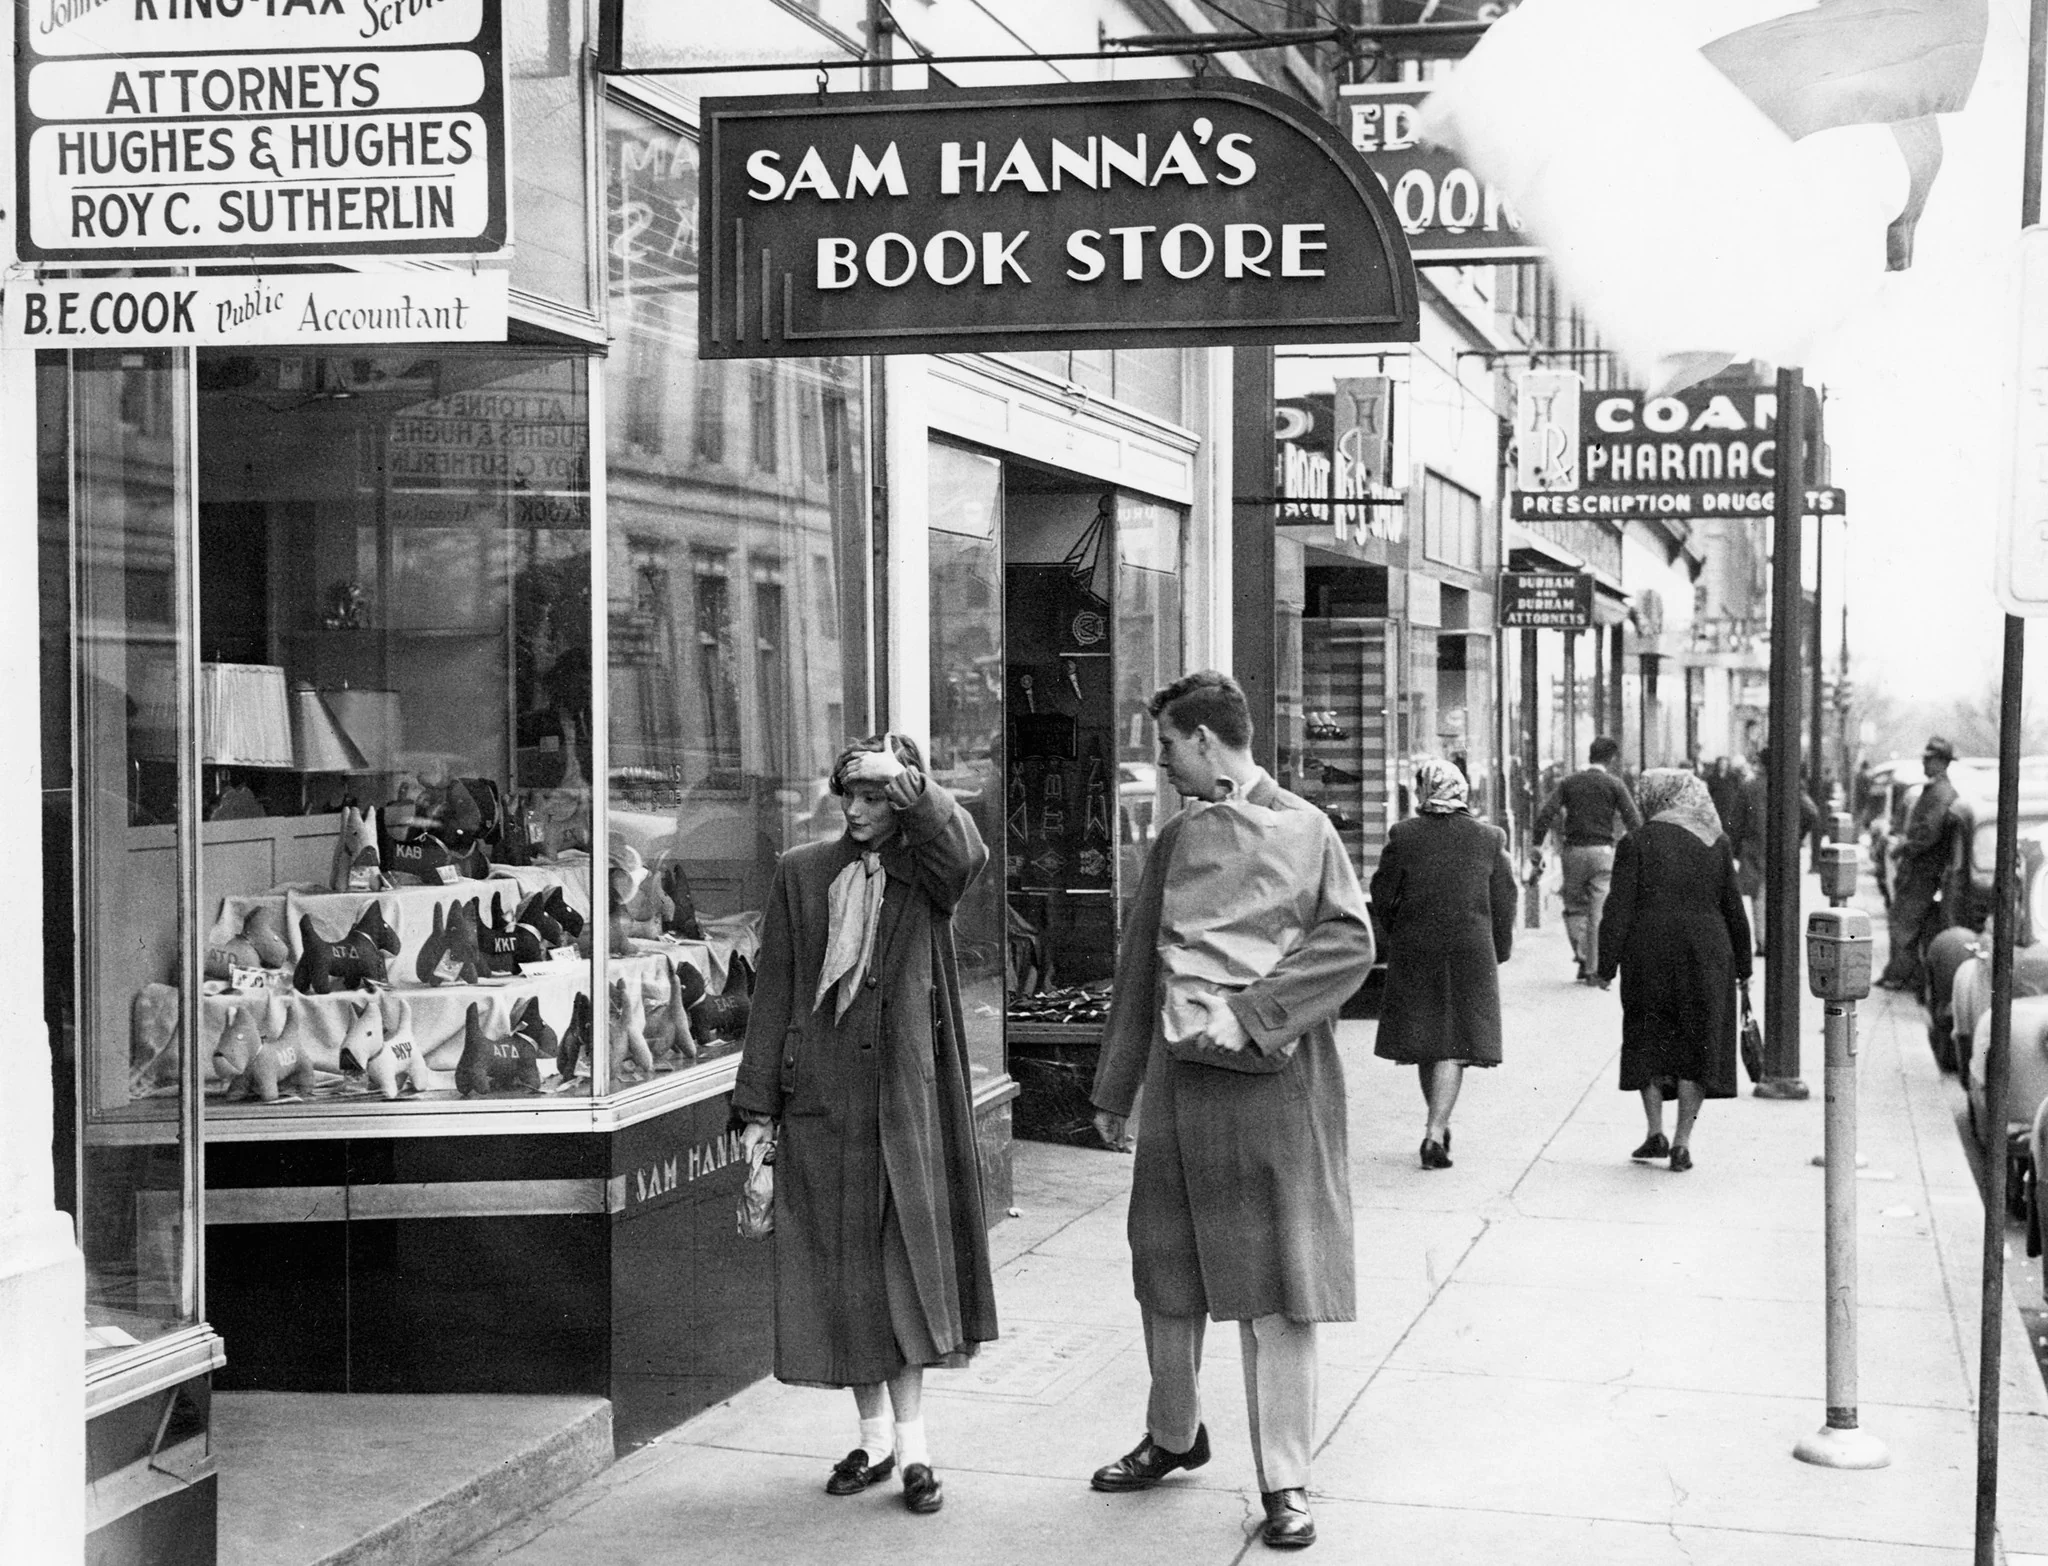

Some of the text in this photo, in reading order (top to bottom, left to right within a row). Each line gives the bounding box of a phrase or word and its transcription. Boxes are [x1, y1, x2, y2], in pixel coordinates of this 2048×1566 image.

[106, 62, 381, 115] ATTORNEYS
[57, 120, 472, 177] HUGHES & HUGHES
[745, 117, 1257, 201] SAM HANNA'S
[71, 185, 455, 238] ROY C. SUTHERLIN
[816, 223, 1328, 290] BOOK STORE
[216, 288, 284, 334] Public
[297, 295, 470, 332] Accountant
[1587, 440, 1779, 482] PHARMAC
[1522, 490, 1835, 515] PRESCRIPTION DRUGGTS
[1517, 598, 1575, 610] DURHAM
[1518, 576, 1576, 589] DURHAM
[1506, 612, 1587, 625] ATTORNEYS
[636, 1128, 742, 1204] SAM HANN
